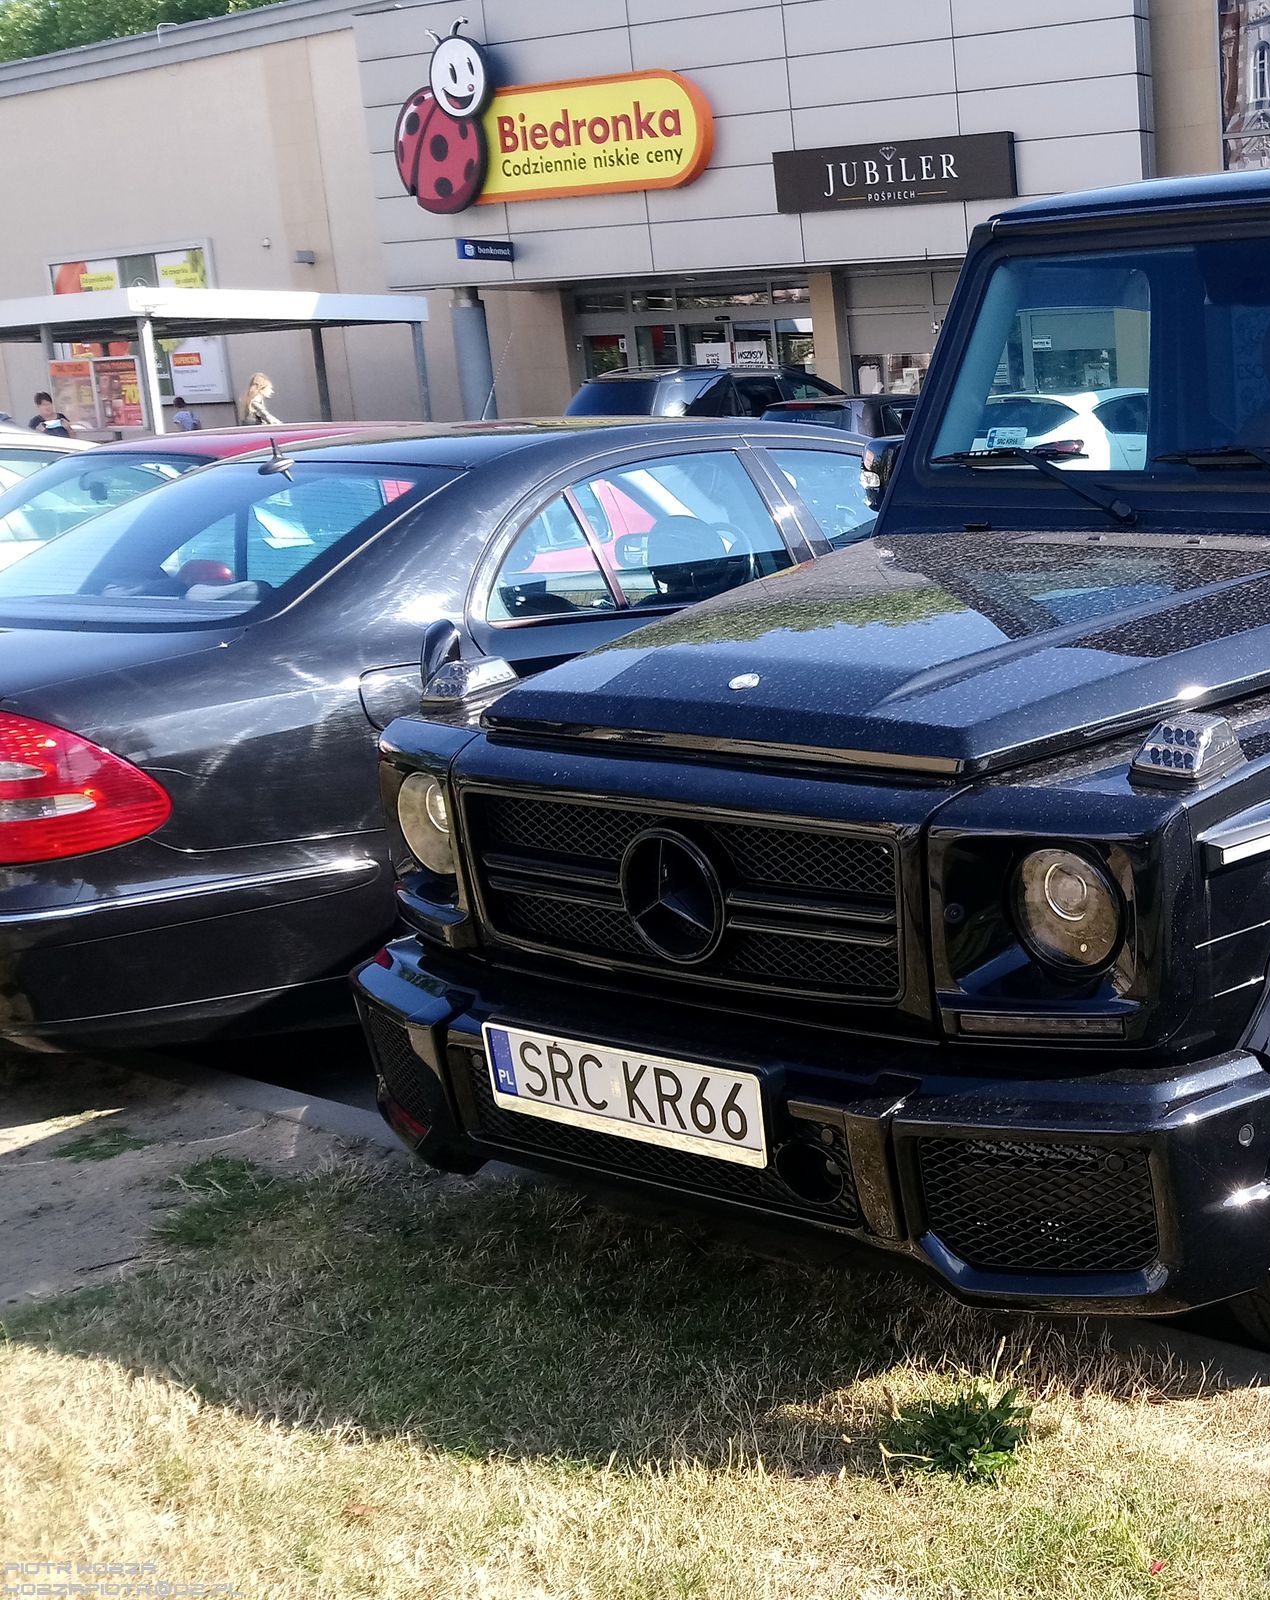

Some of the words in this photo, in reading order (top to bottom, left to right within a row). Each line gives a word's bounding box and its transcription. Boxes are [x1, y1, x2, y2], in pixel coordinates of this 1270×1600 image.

[497, 101, 682, 153] Biedronka
[502, 152, 587, 177] Codziennie
[593, 148, 640, 168] niskie
[646, 148, 683, 165] ceny
[824, 153, 958, 197] JUBILER
[867, 190, 916, 202] POŚPIECH
[477, 246, 511, 256] bankomat
[499, 1068, 514, 1086] PL
[519, 1040, 609, 1111] SRC
[622, 1060, 749, 1141] KR66
